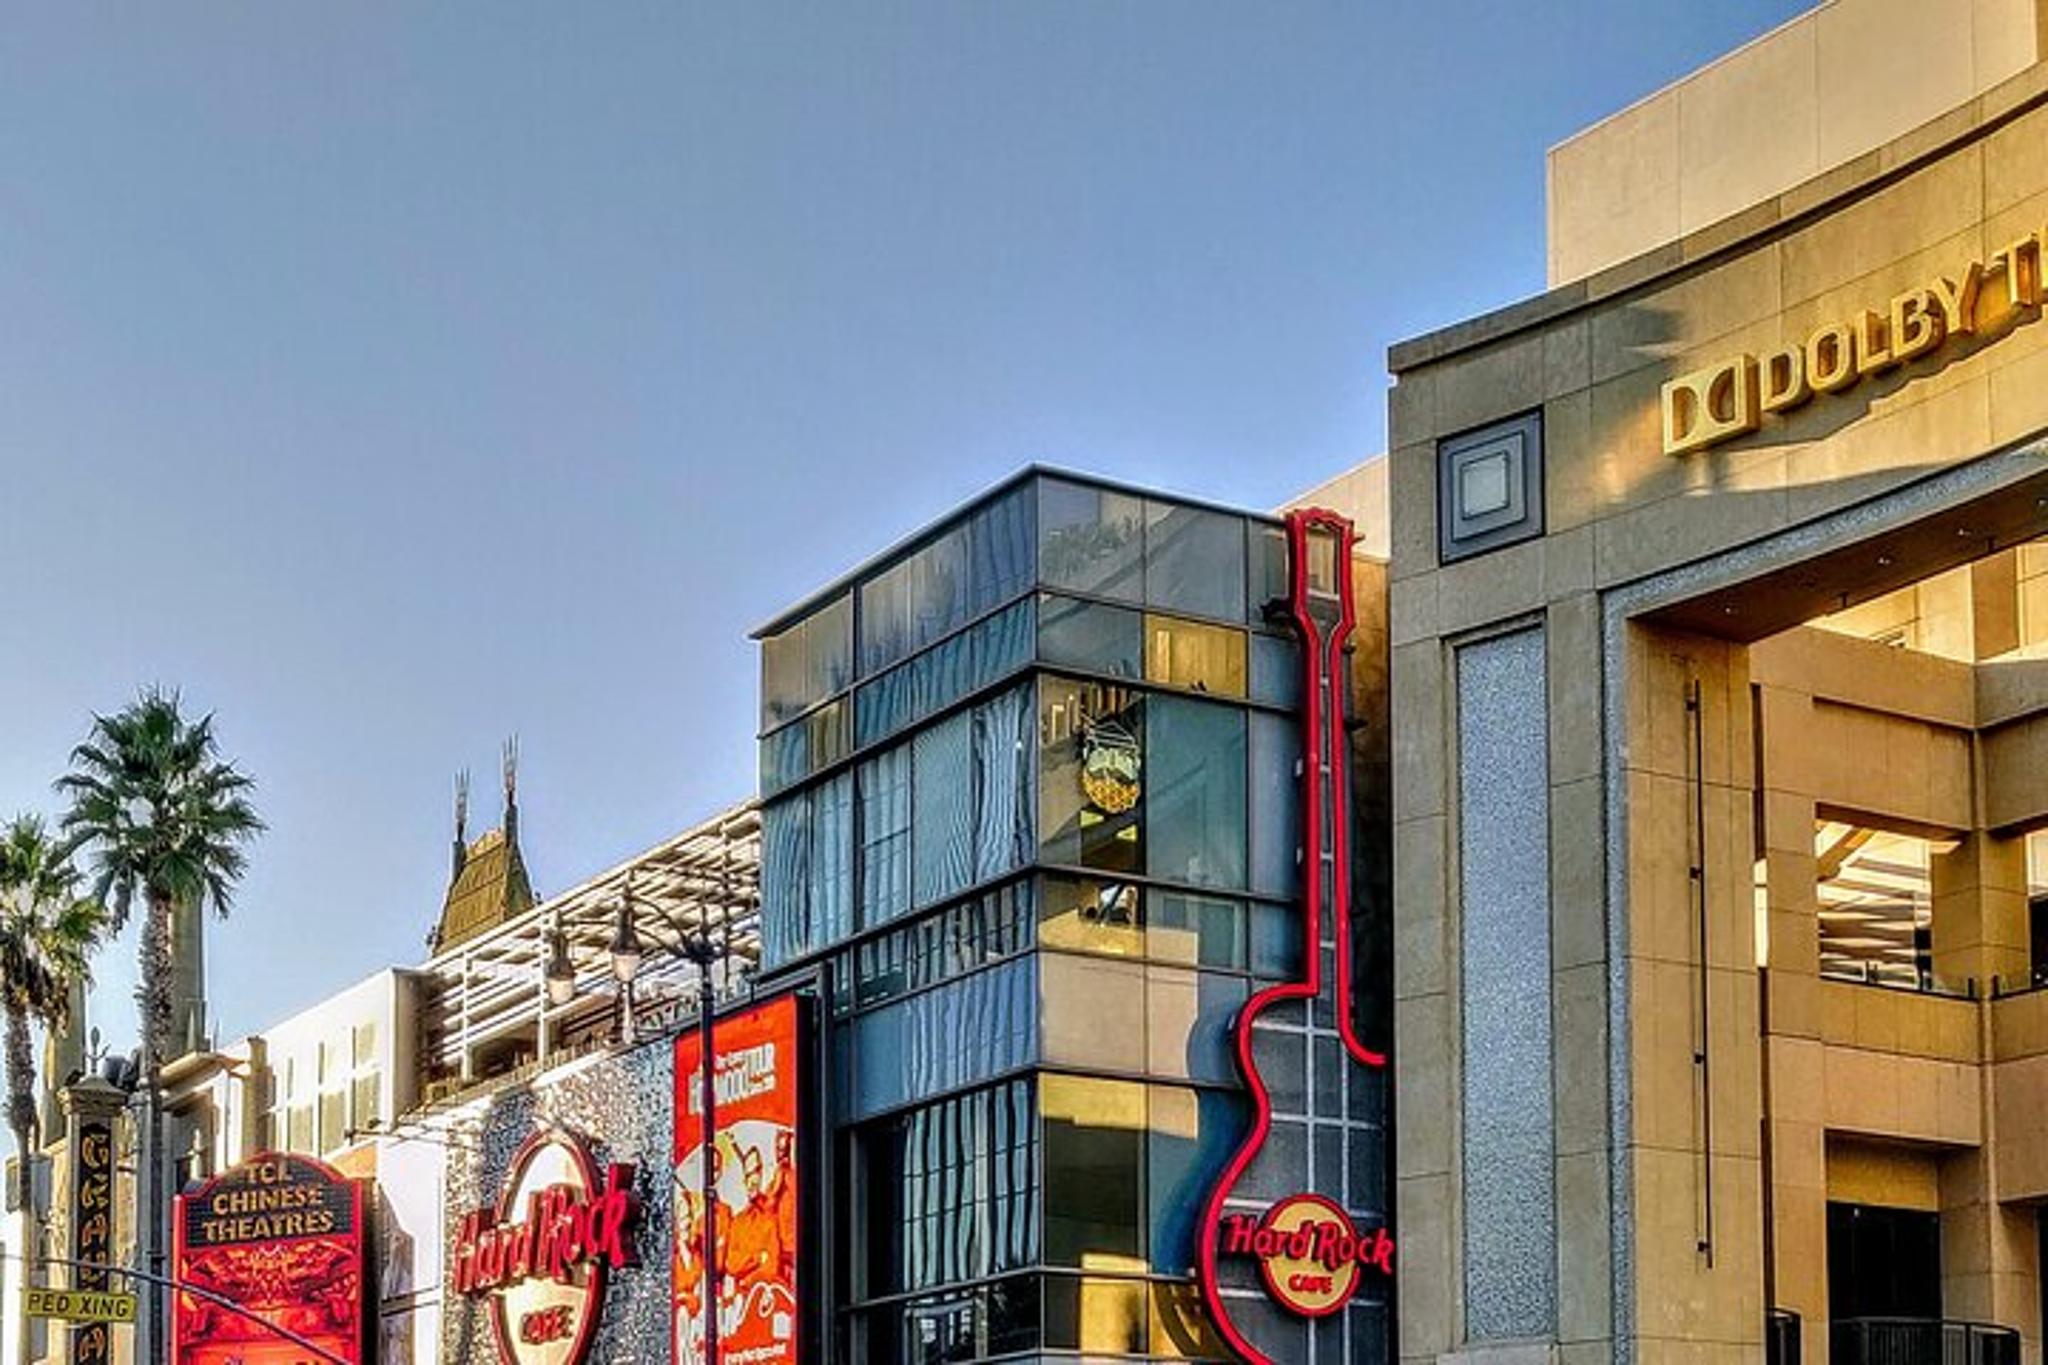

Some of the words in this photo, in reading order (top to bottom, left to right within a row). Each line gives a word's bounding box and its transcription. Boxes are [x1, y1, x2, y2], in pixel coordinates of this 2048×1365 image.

[1760, 261, 1982, 412] DOLBY
[1991, 227, 2048, 305] T
[247, 1160, 294, 1185] TCL
[212, 1182, 324, 1216] CHINESE
[202, 1210, 334, 1242] THEATRES
[454, 1191, 538, 1294] Hard
[537, 1163, 630, 1285] Rock
[1228, 1213, 1316, 1260] Hard
[1311, 1219, 1396, 1274] Rock
[1288, 1273, 1334, 1294] CAFE
[27, 1292, 70, 1314] PED
[79, 1296, 130, 1318] XING
